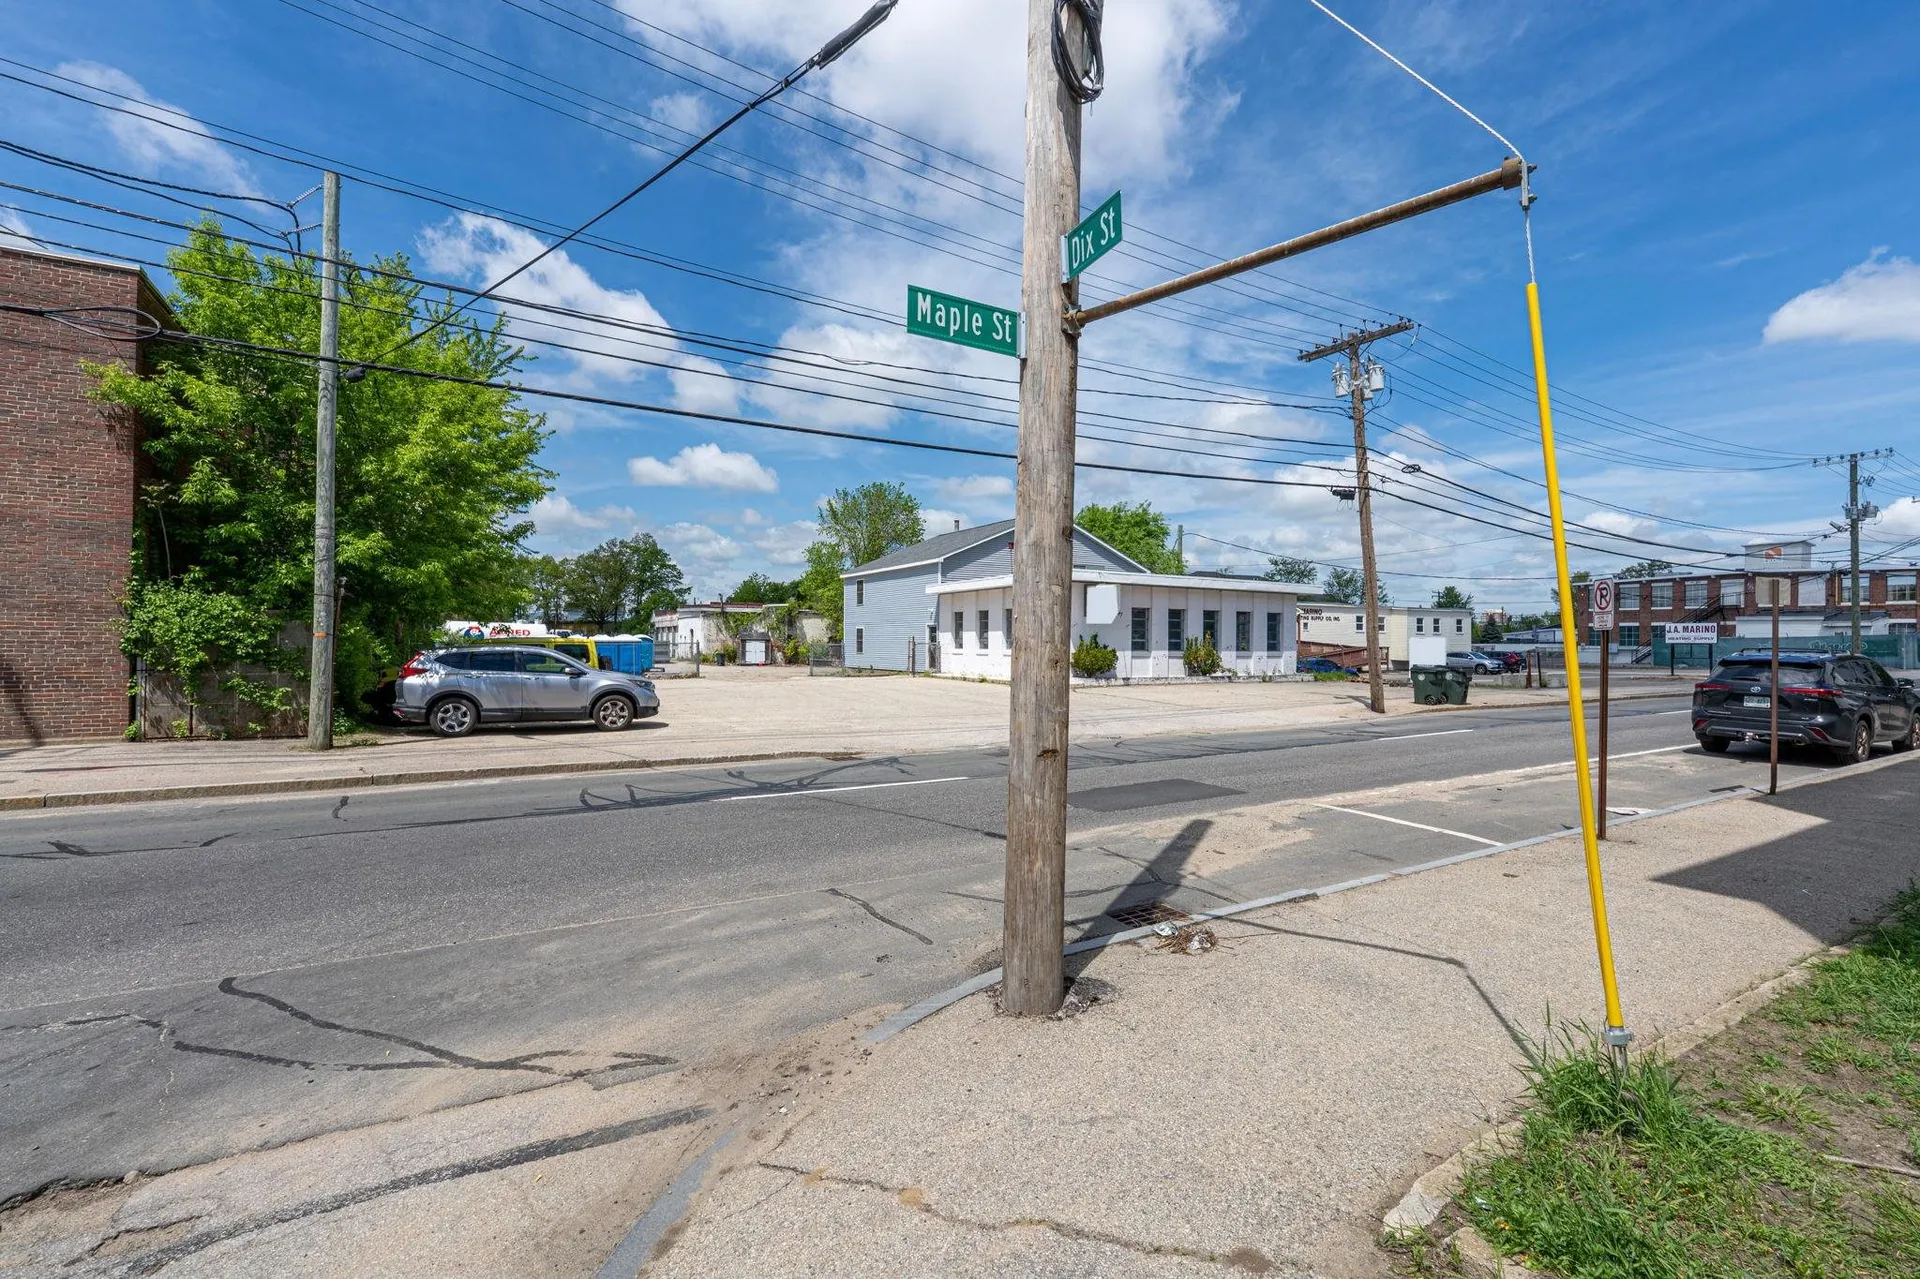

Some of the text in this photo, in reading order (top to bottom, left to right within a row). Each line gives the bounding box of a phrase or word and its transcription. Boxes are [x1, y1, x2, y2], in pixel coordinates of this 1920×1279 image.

[1071, 206, 1116, 269] Dix St
[917, 291, 1012, 343] Maple St
[1667, 625, 1716, 634] J.A. MARINO
